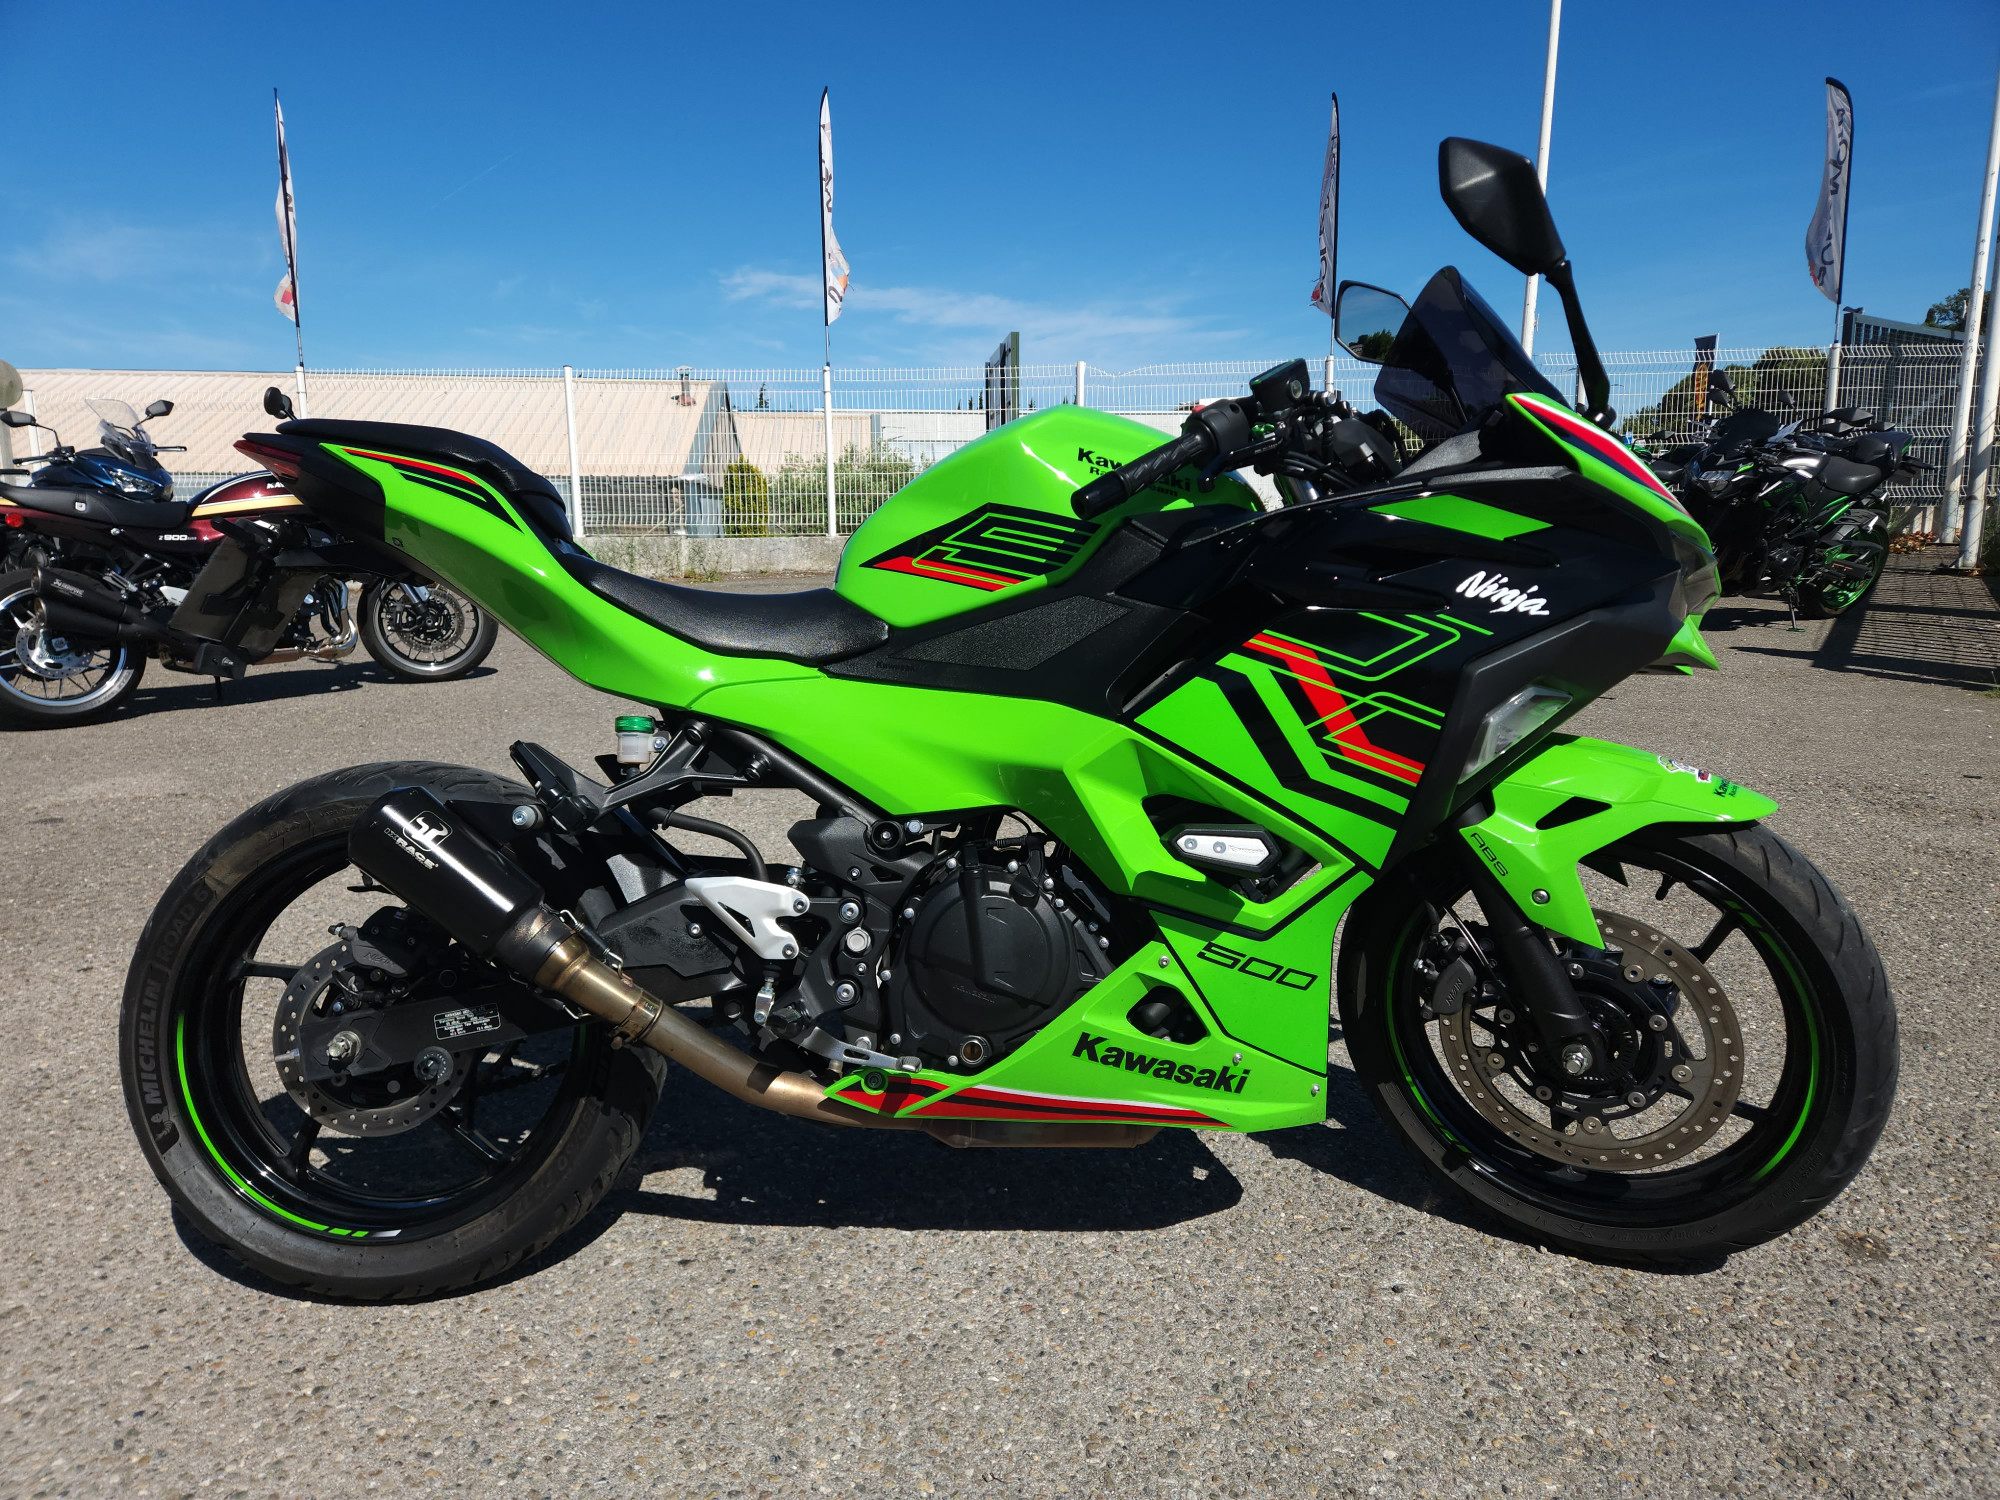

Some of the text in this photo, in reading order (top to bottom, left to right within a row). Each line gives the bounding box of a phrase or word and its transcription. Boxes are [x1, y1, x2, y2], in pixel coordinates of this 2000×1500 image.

[1077, 447, 1191, 492] Kawaki
[1456, 570, 1550, 616] Ninja
[1470, 832, 1509, 877] ABS
[1196, 940, 1319, 991] 500
[137, 978, 163, 1105] MICHELIN
[1072, 1031, 1251, 1094] Kawasaki
